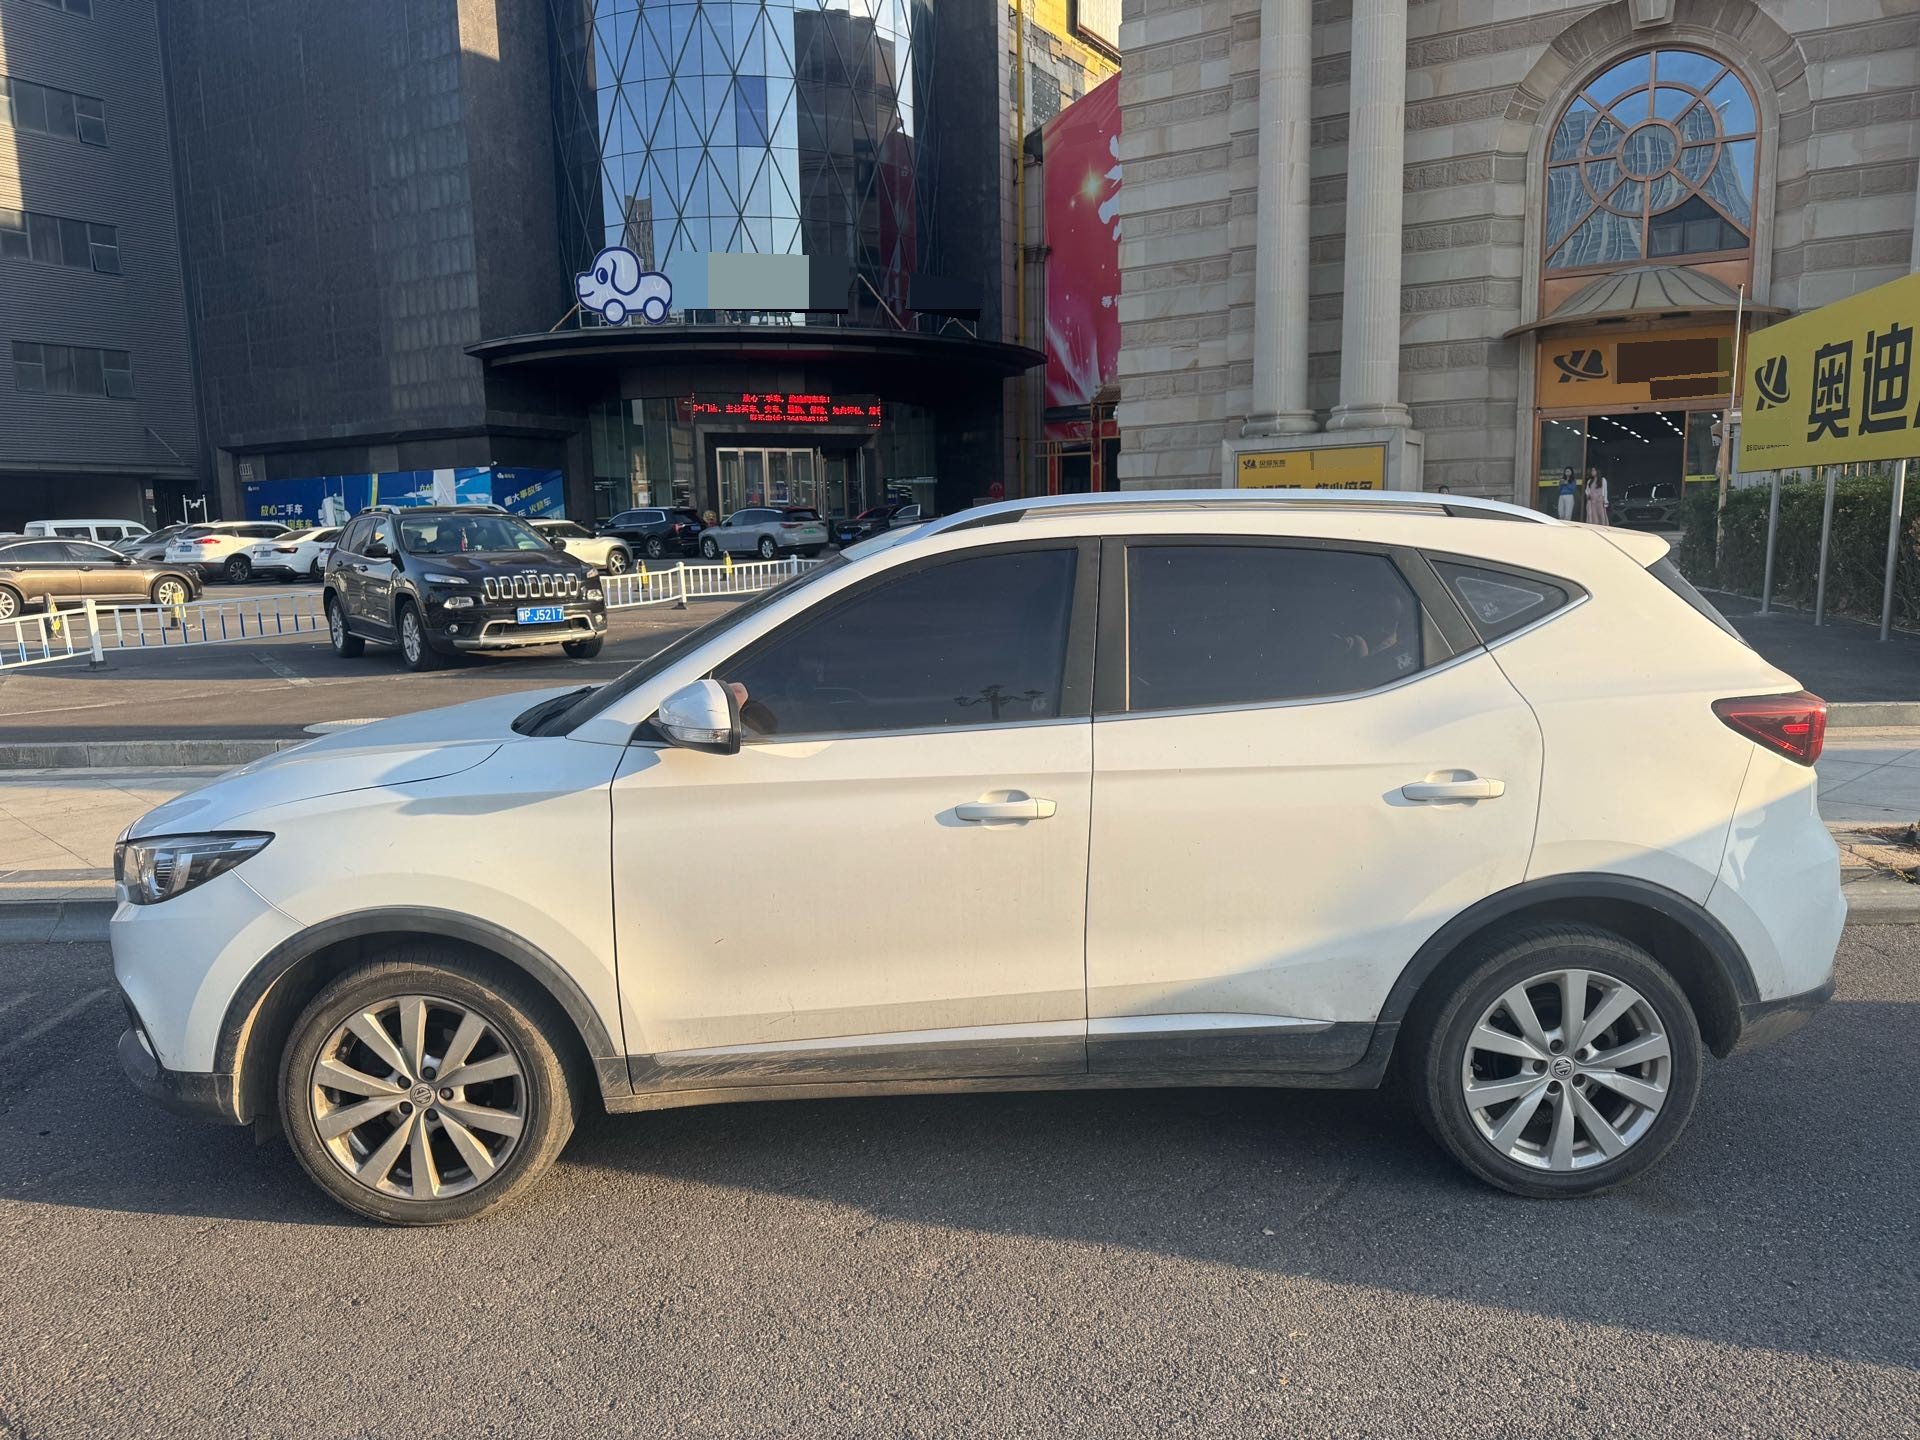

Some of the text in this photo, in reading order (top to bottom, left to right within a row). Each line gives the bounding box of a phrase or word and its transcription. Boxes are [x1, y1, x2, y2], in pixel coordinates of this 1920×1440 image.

[1807, 322, 1920, 442] 奥迪
[504, 482, 543, 506] 重大事故车
[260, 503, 303, 517] 放心二手车
